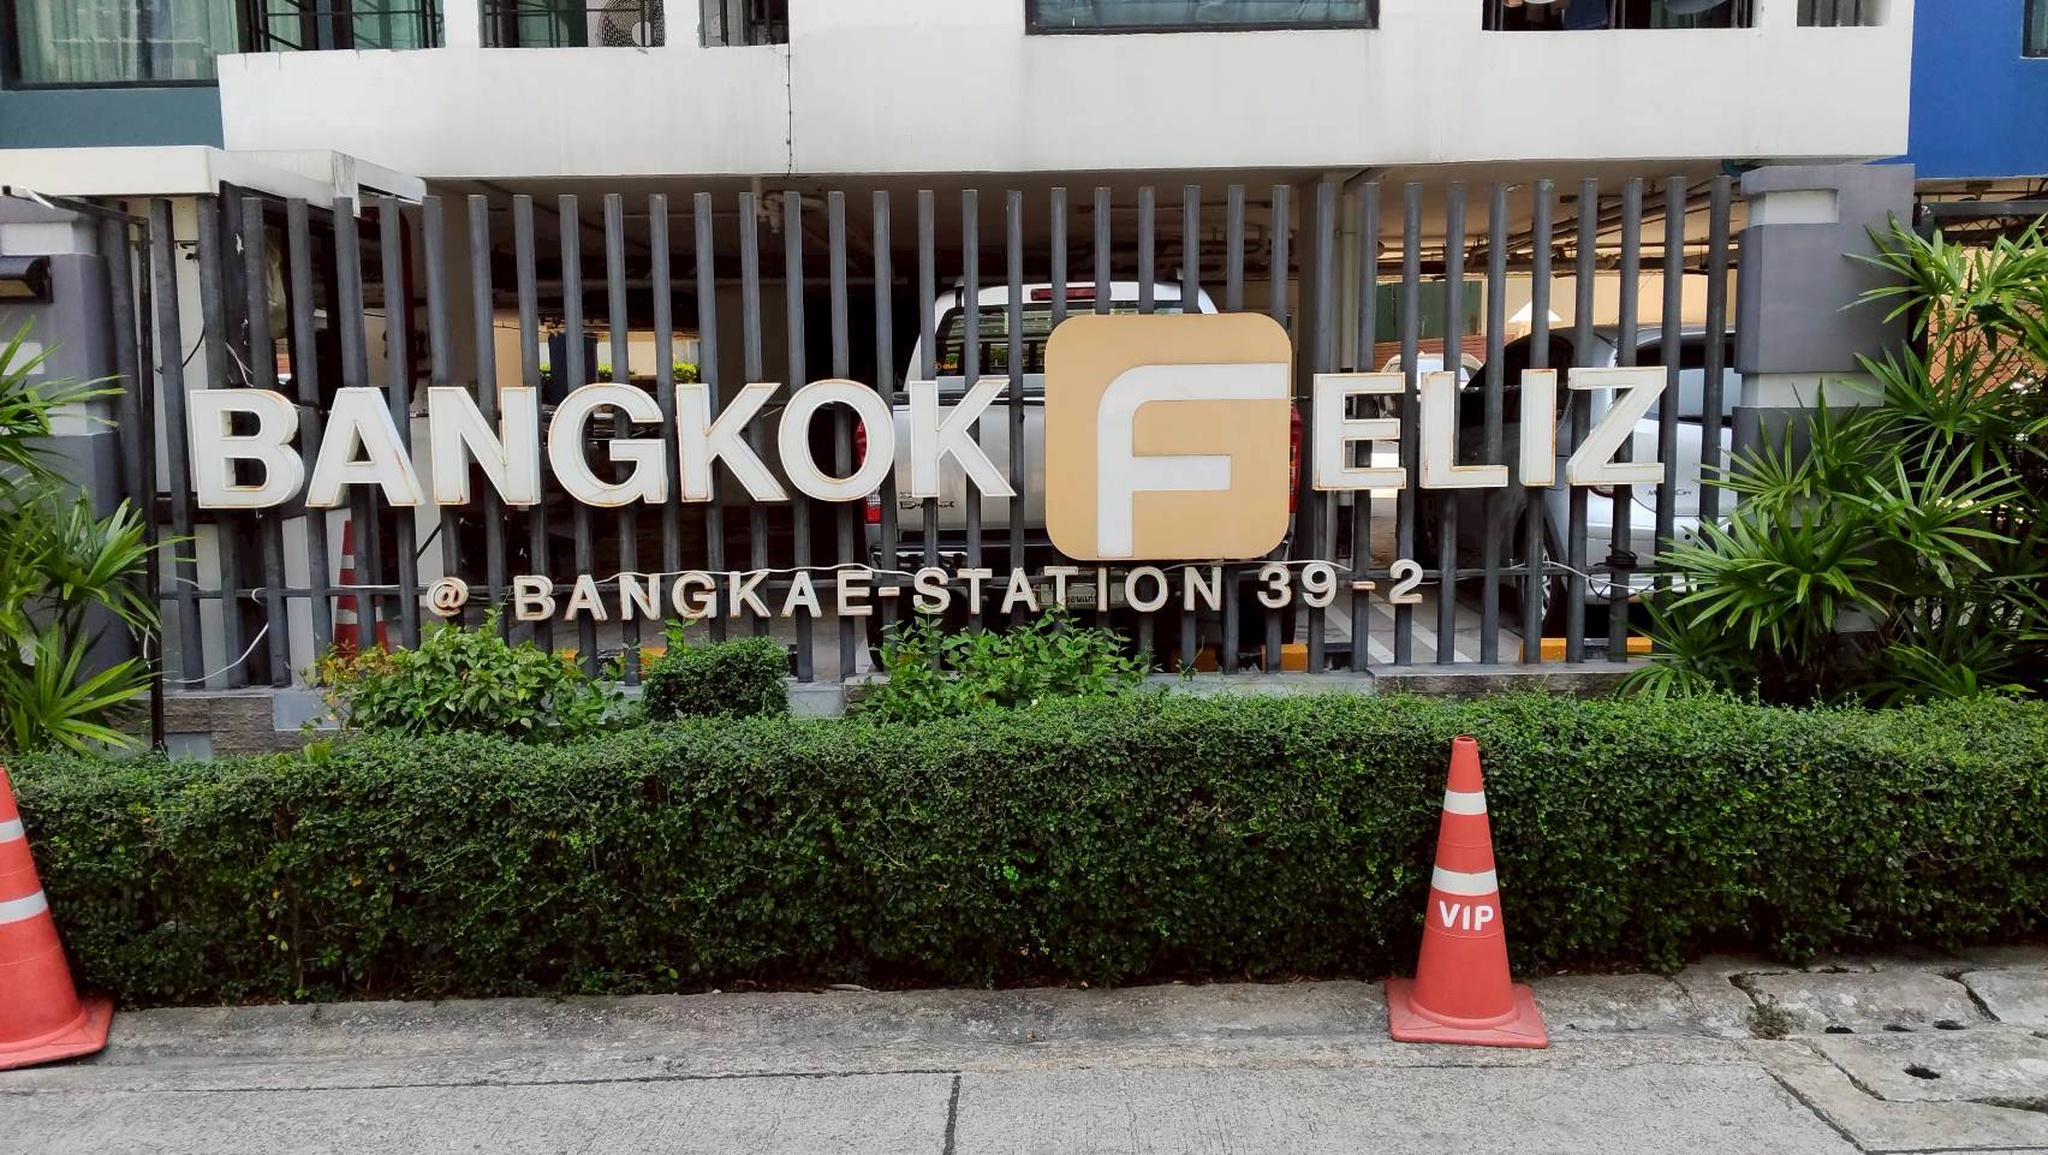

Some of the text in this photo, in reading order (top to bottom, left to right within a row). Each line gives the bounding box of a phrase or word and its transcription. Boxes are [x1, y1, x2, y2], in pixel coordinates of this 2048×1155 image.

[191, 379, 1016, 508] BANGKOK
[427, 559, 1423, 621] @ BANGKAE-STATION 39-2
[1439, 901, 1494, 931] VIP
